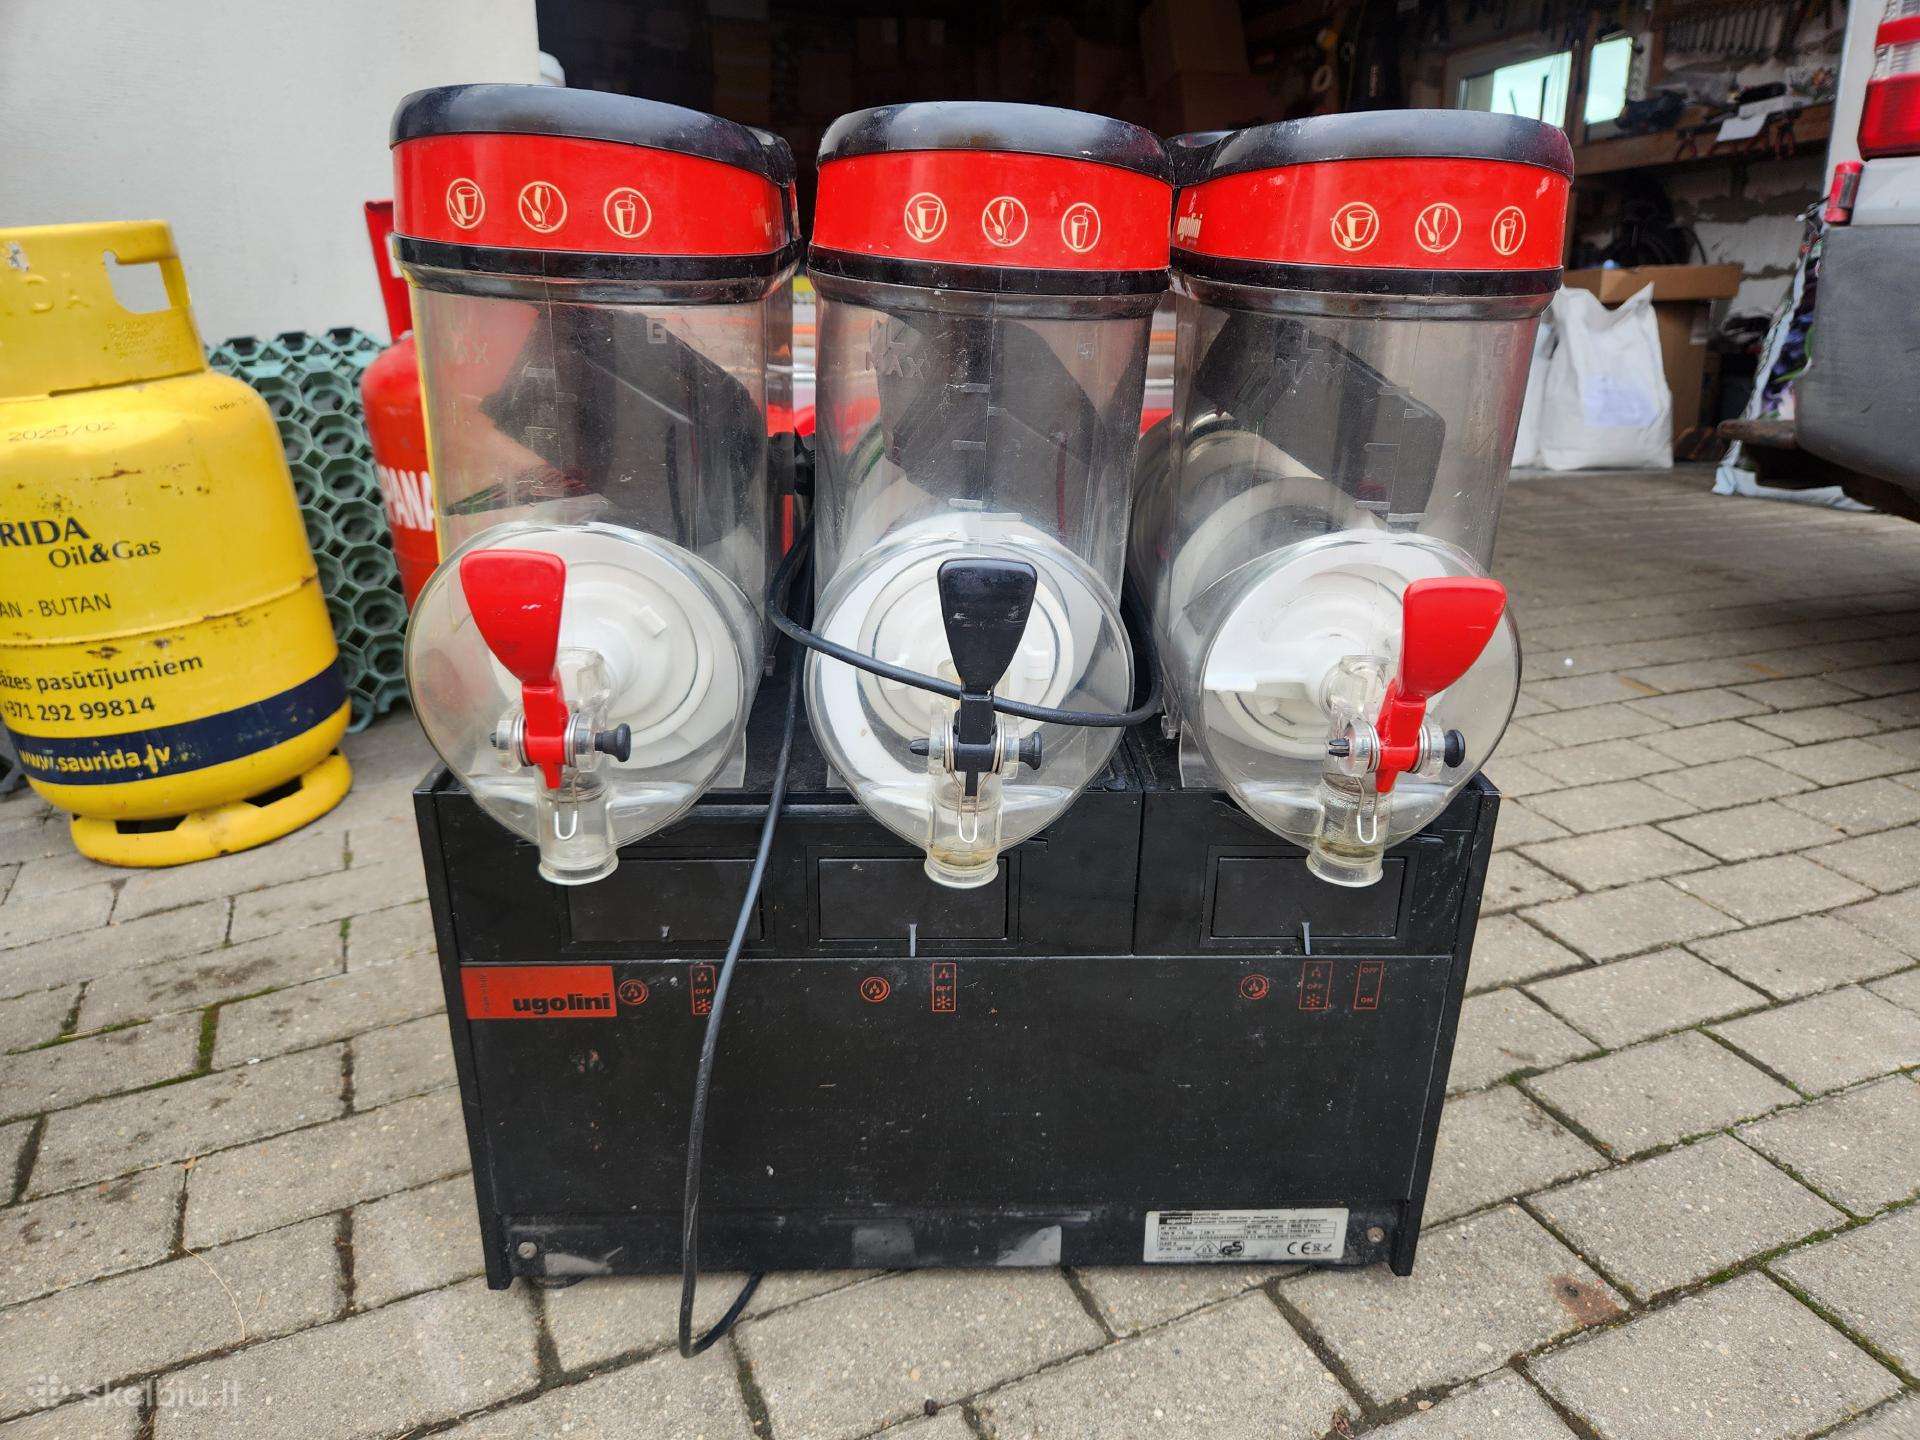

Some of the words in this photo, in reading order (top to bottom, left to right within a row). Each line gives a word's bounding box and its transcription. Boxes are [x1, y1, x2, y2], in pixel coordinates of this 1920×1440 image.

[0, 516, 90, 547] RIDA
[48, 540, 161, 568] Oil&Gas
[38, 592, 112, 617] BUTAN
[36, 655, 203, 694] pasūtījumiem
[37, 704, 75, 721] 292
[79, 697, 155, 720] 99814
[512, 992, 611, 1015] ugolini
